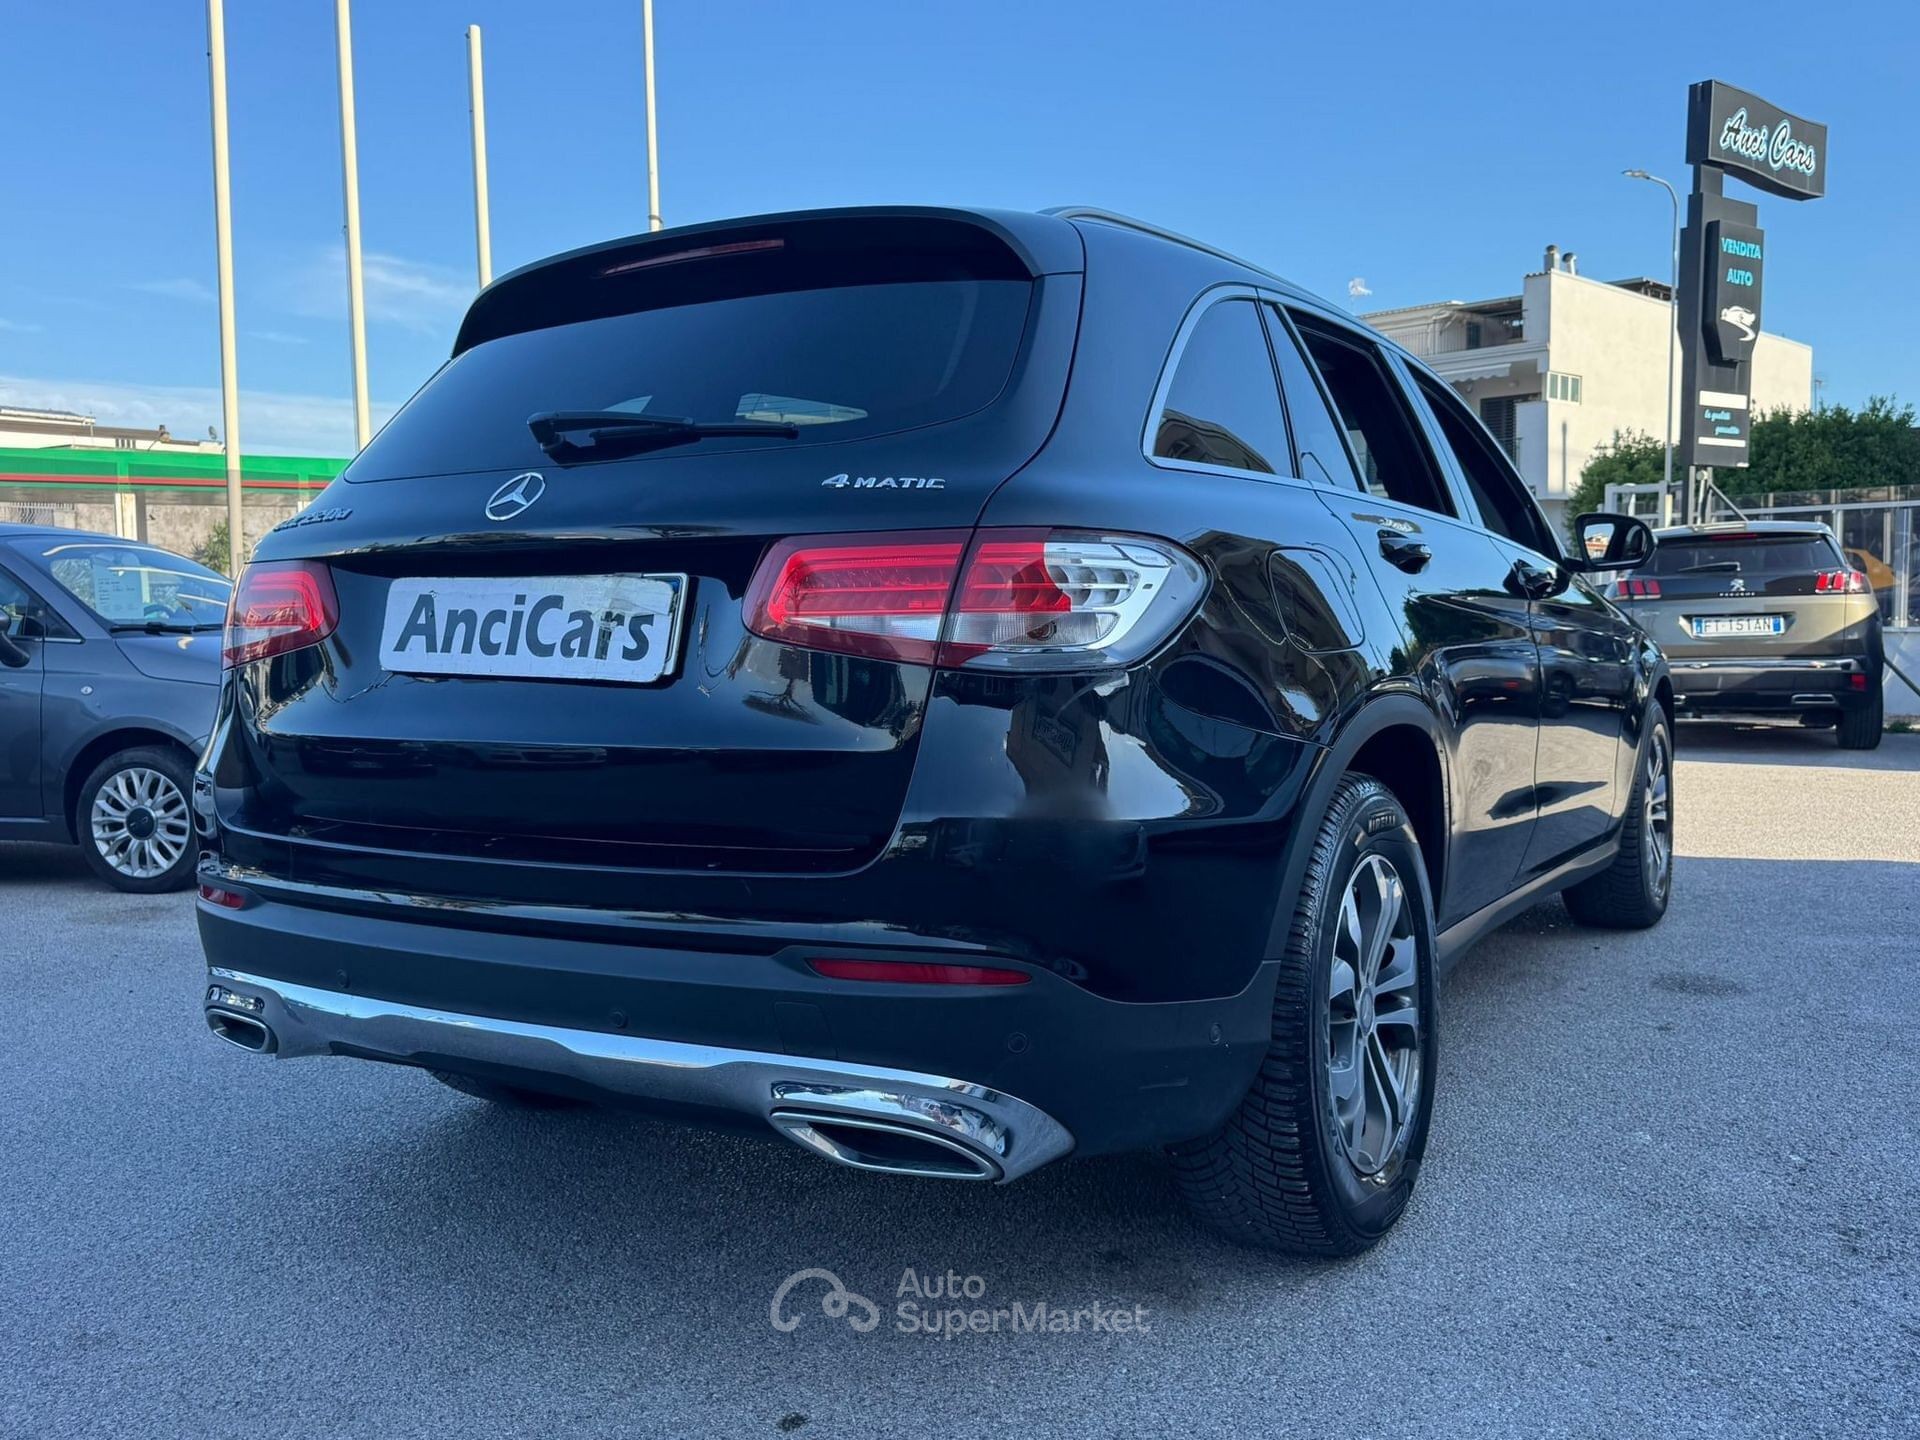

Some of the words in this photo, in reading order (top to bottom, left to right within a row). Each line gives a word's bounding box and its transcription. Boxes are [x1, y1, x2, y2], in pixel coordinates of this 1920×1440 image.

[1720, 108, 1768, 161] Anci
[1769, 119, 1815, 176] Cars
[1721, 237, 1761, 260] VENDITA
[1726, 268, 1753, 286] AUTO
[821, 473, 946, 489] 4MATIC
[393, 594, 655, 662] AnciCars
